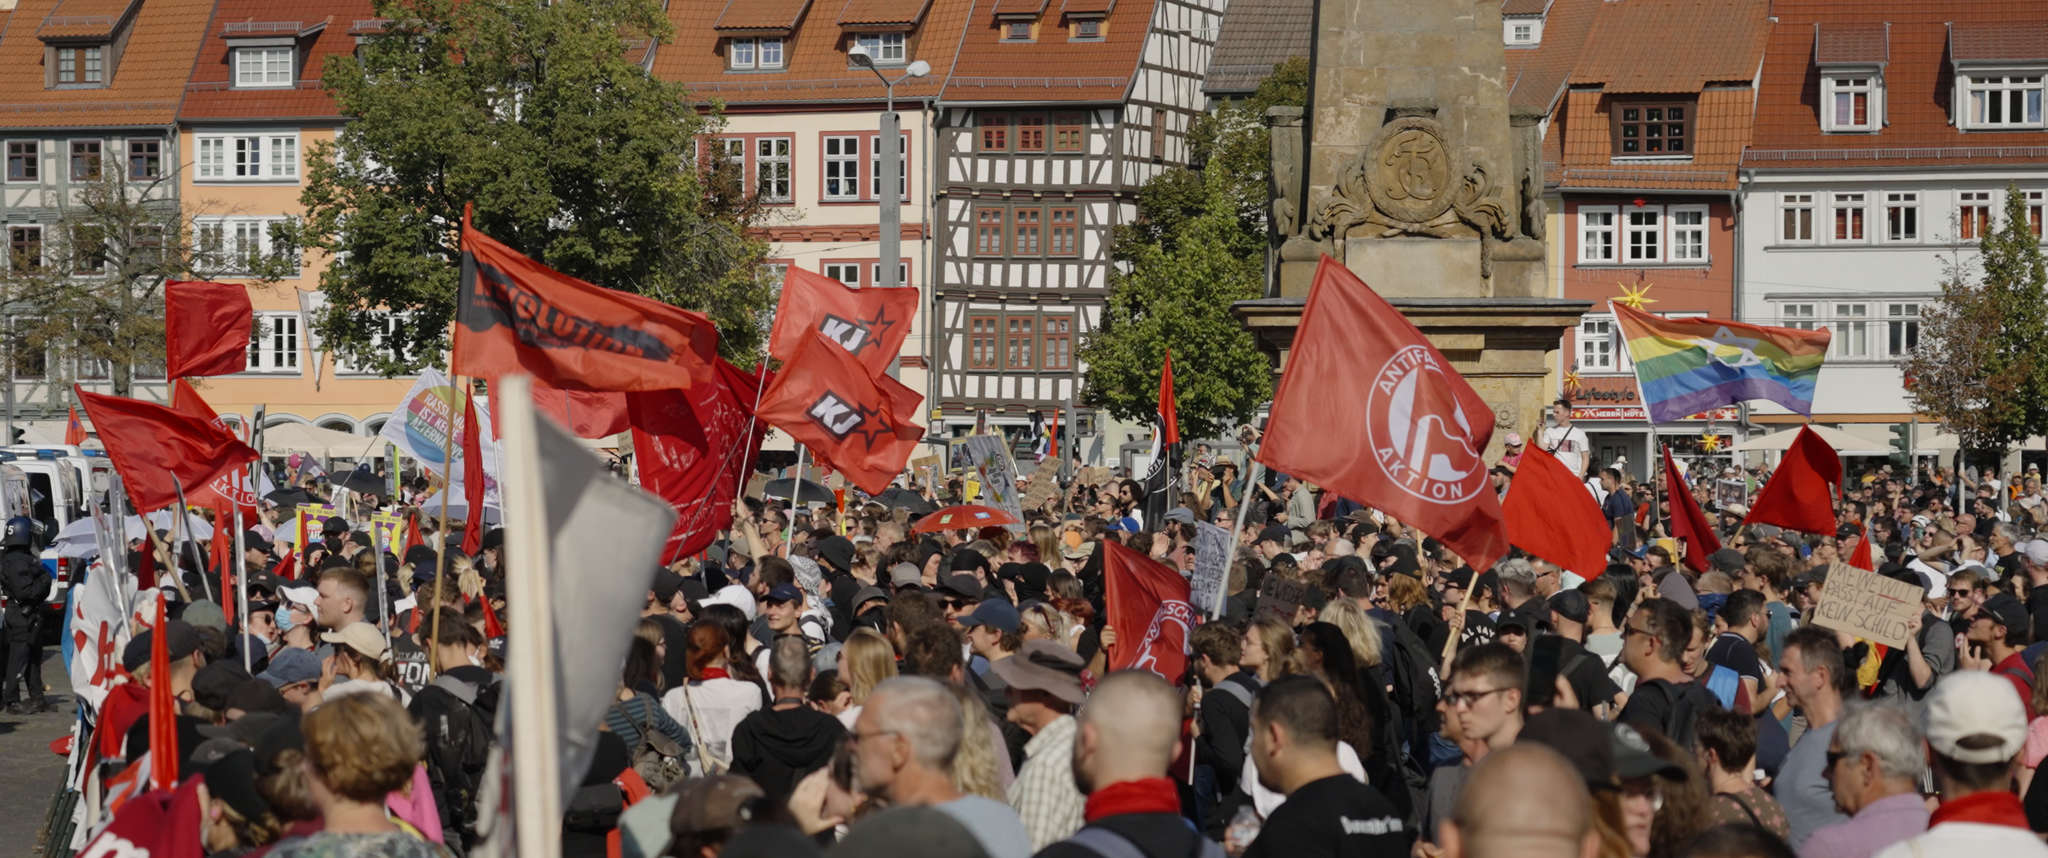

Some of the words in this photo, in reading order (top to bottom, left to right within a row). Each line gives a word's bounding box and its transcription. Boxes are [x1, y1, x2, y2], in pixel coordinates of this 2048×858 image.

[822, 317, 867, 352] KJ
[423, 392, 464, 428] RASSIMU
[810, 394, 862, 435] KJ
[434, 417, 459, 442] KEIE
[1378, 446, 1463, 499] AKTION
[1831, 563, 1877, 594] MEINE
[1825, 580, 1860, 605] PASST
[1864, 599, 1897, 617] AUF
[1817, 601, 1854, 622] KEIN
[1855, 609, 1908, 640] SCHILD
